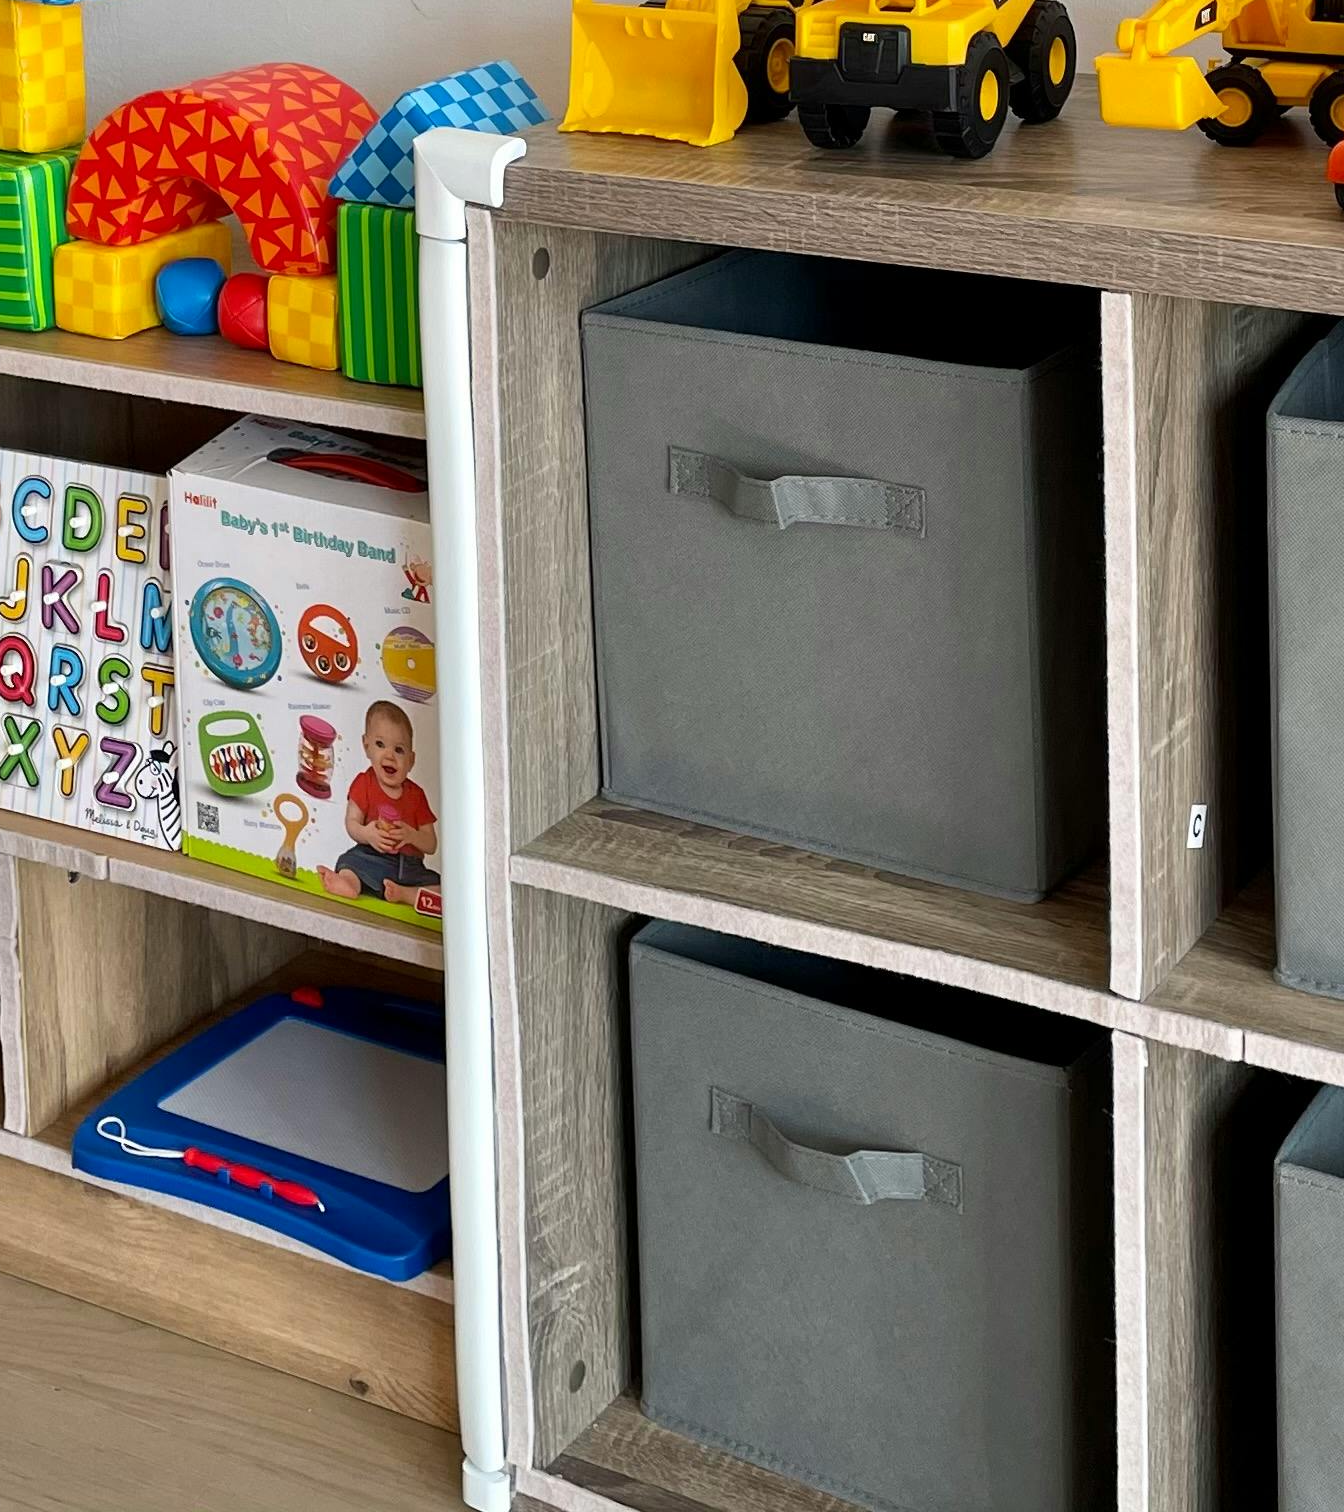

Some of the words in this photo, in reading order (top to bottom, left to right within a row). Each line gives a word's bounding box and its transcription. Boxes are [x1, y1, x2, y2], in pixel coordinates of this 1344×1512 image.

[12, 478, 51, 544] C
[62, 486, 104, 552] D
[116, 497, 148, 564] E
[221, 510, 269, 536] Baby's
[271, 521, 290, 538] 1st
[293, 526, 355, 557] Birthday
[356, 541, 397, 564] Band
[42, 565, 80, 634] K
[95, 573, 125, 642] L
[47, 645, 84, 716] R
[95, 657, 131, 725] S
[141, 666, 175, 736] T
[52, 727, 90, 796] Y
[95, 737, 137, 809] Z
[85, 807, 124, 828] Melissa
[1192, 814, 1203, 838] C
